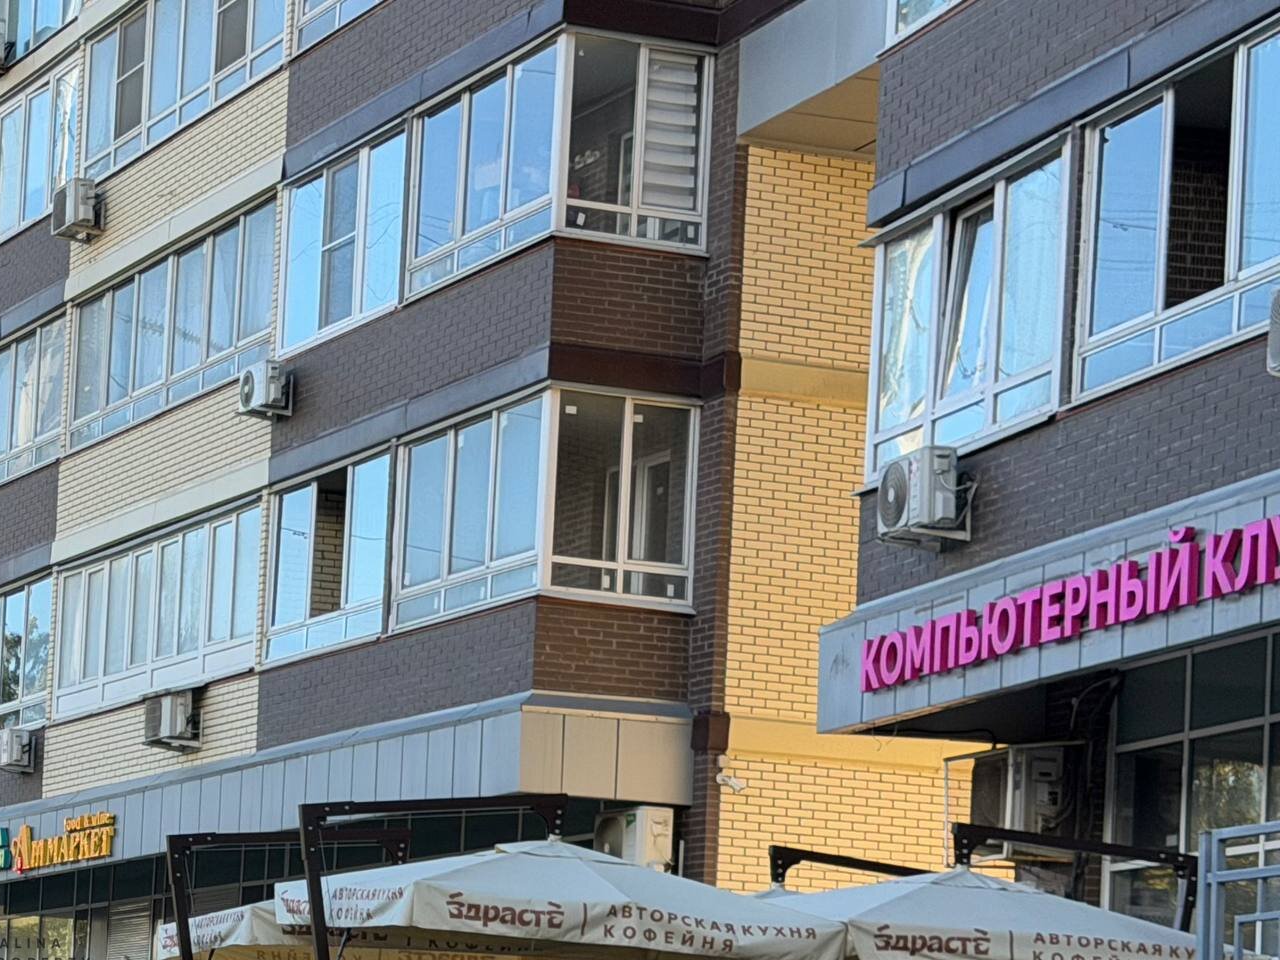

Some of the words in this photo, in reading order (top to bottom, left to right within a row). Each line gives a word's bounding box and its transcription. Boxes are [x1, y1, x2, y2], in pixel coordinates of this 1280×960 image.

[861, 527, 1199, 692] КОМПЬЮТЕРНЫЙ
[603, 924, 734, 953] КОФЕЙНЯ
[606, 903, 736, 936] АВТОРСКАЯ
[742, 924, 817, 941] КУХНЯ
[1033, 931, 1163, 958] АВТОРСКАЯ
